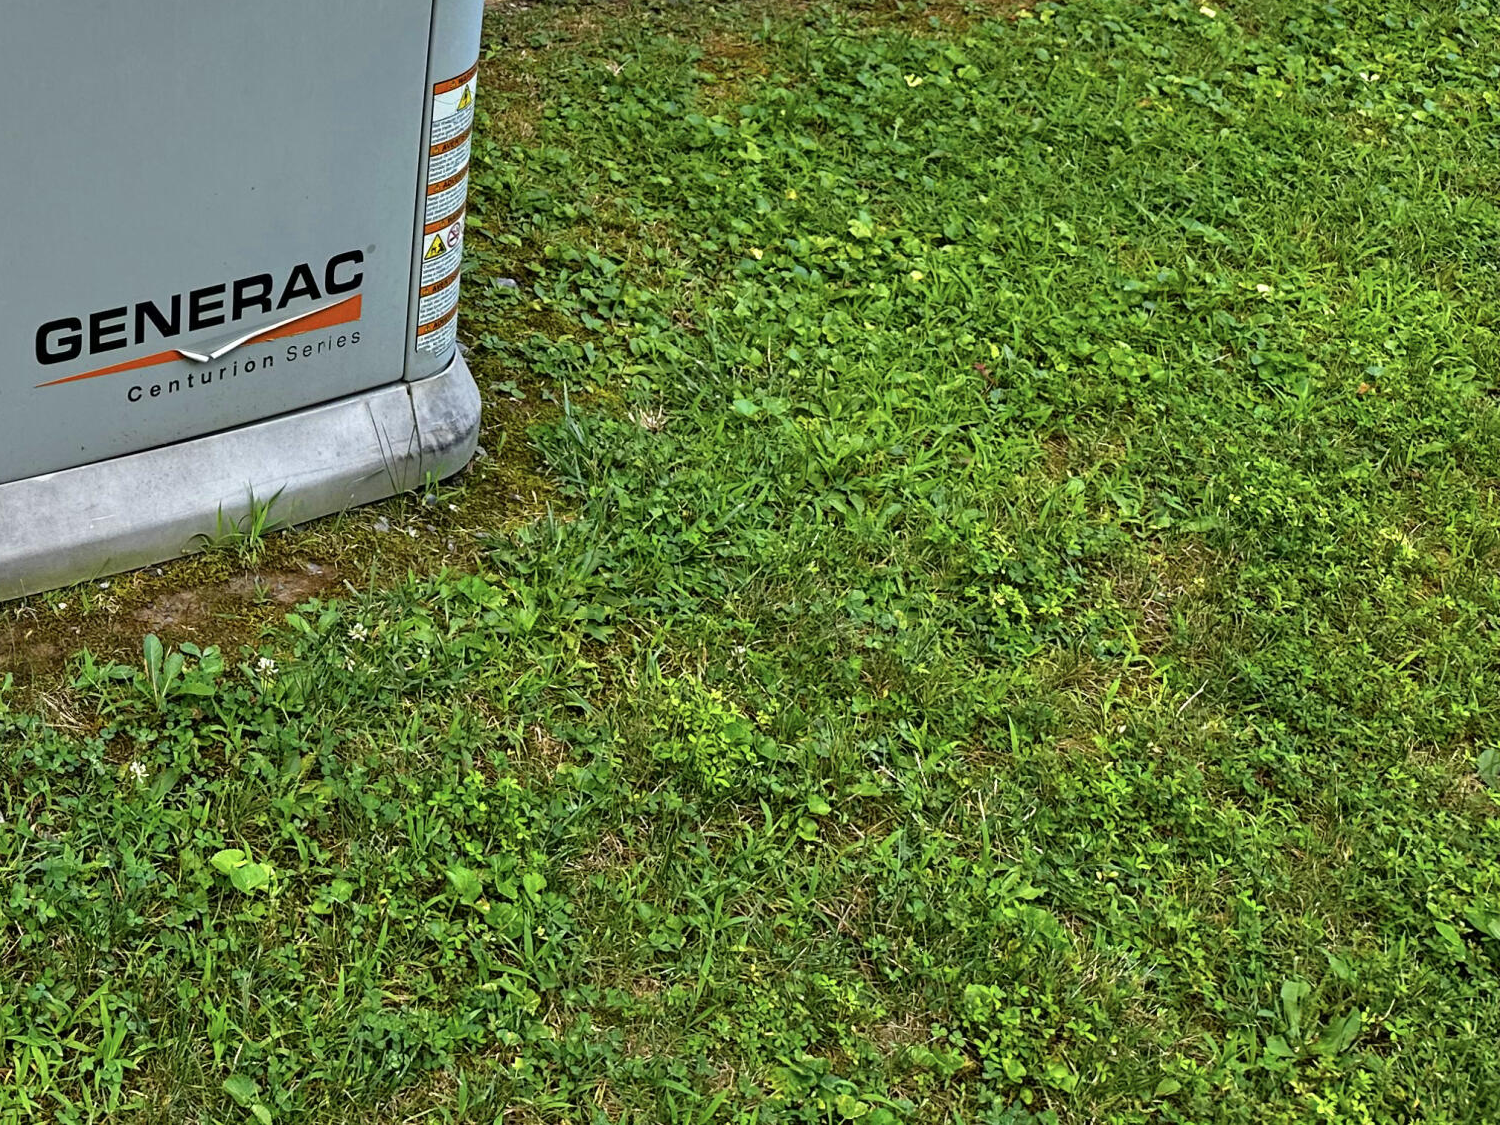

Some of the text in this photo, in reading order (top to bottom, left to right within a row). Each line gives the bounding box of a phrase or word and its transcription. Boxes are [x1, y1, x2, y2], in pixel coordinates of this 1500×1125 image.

[35, 249, 364, 365] GENERAC
[127, 329, 362, 403] Centurion Series
